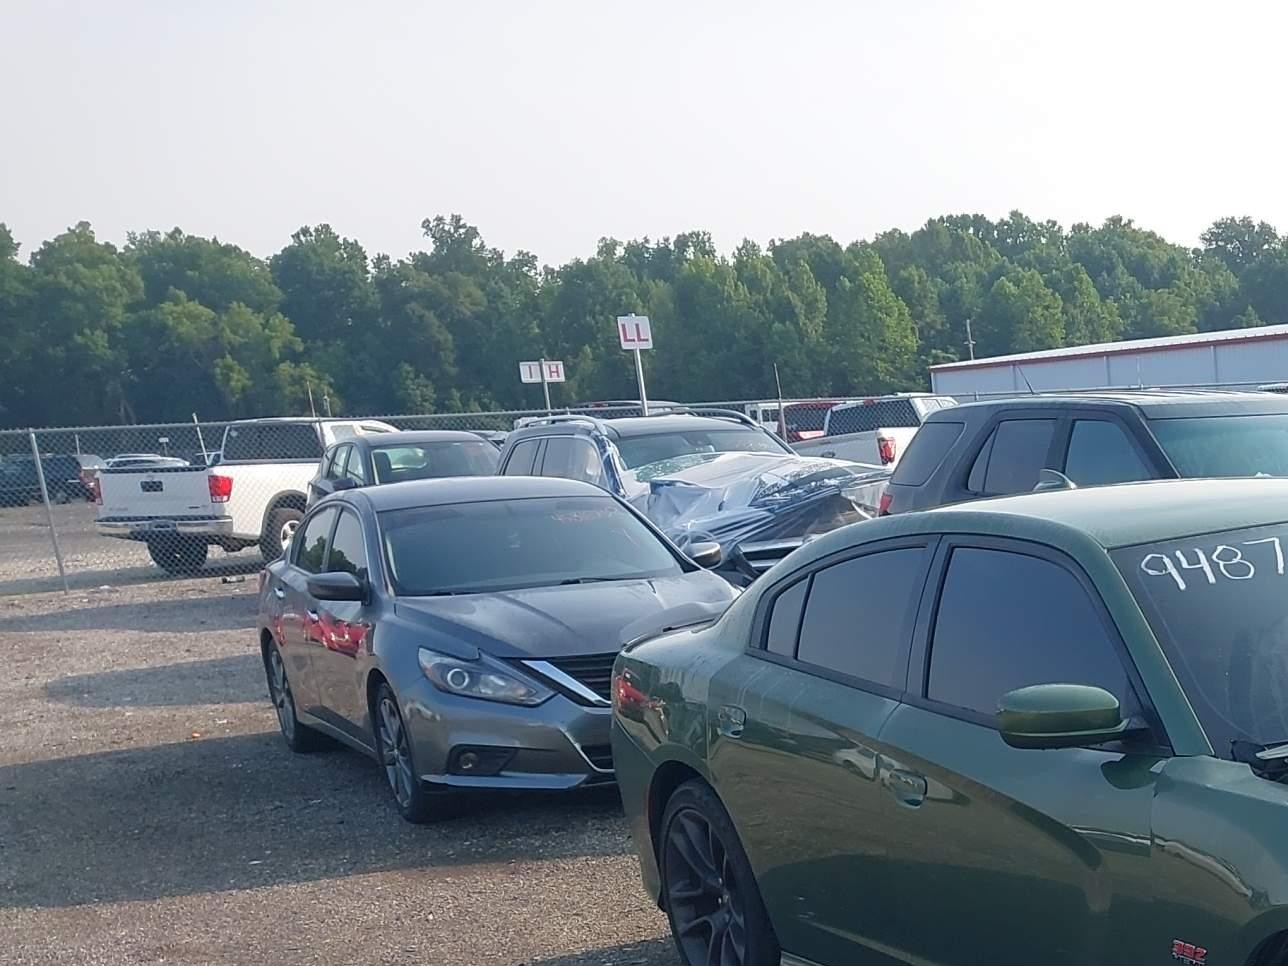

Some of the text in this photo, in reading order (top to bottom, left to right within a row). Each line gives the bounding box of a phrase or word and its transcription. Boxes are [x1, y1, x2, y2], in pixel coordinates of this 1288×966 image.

[621, 323, 649, 342] LL
[549, 364, 560, 378] H
[1140, 536, 1285, 591] 9487
